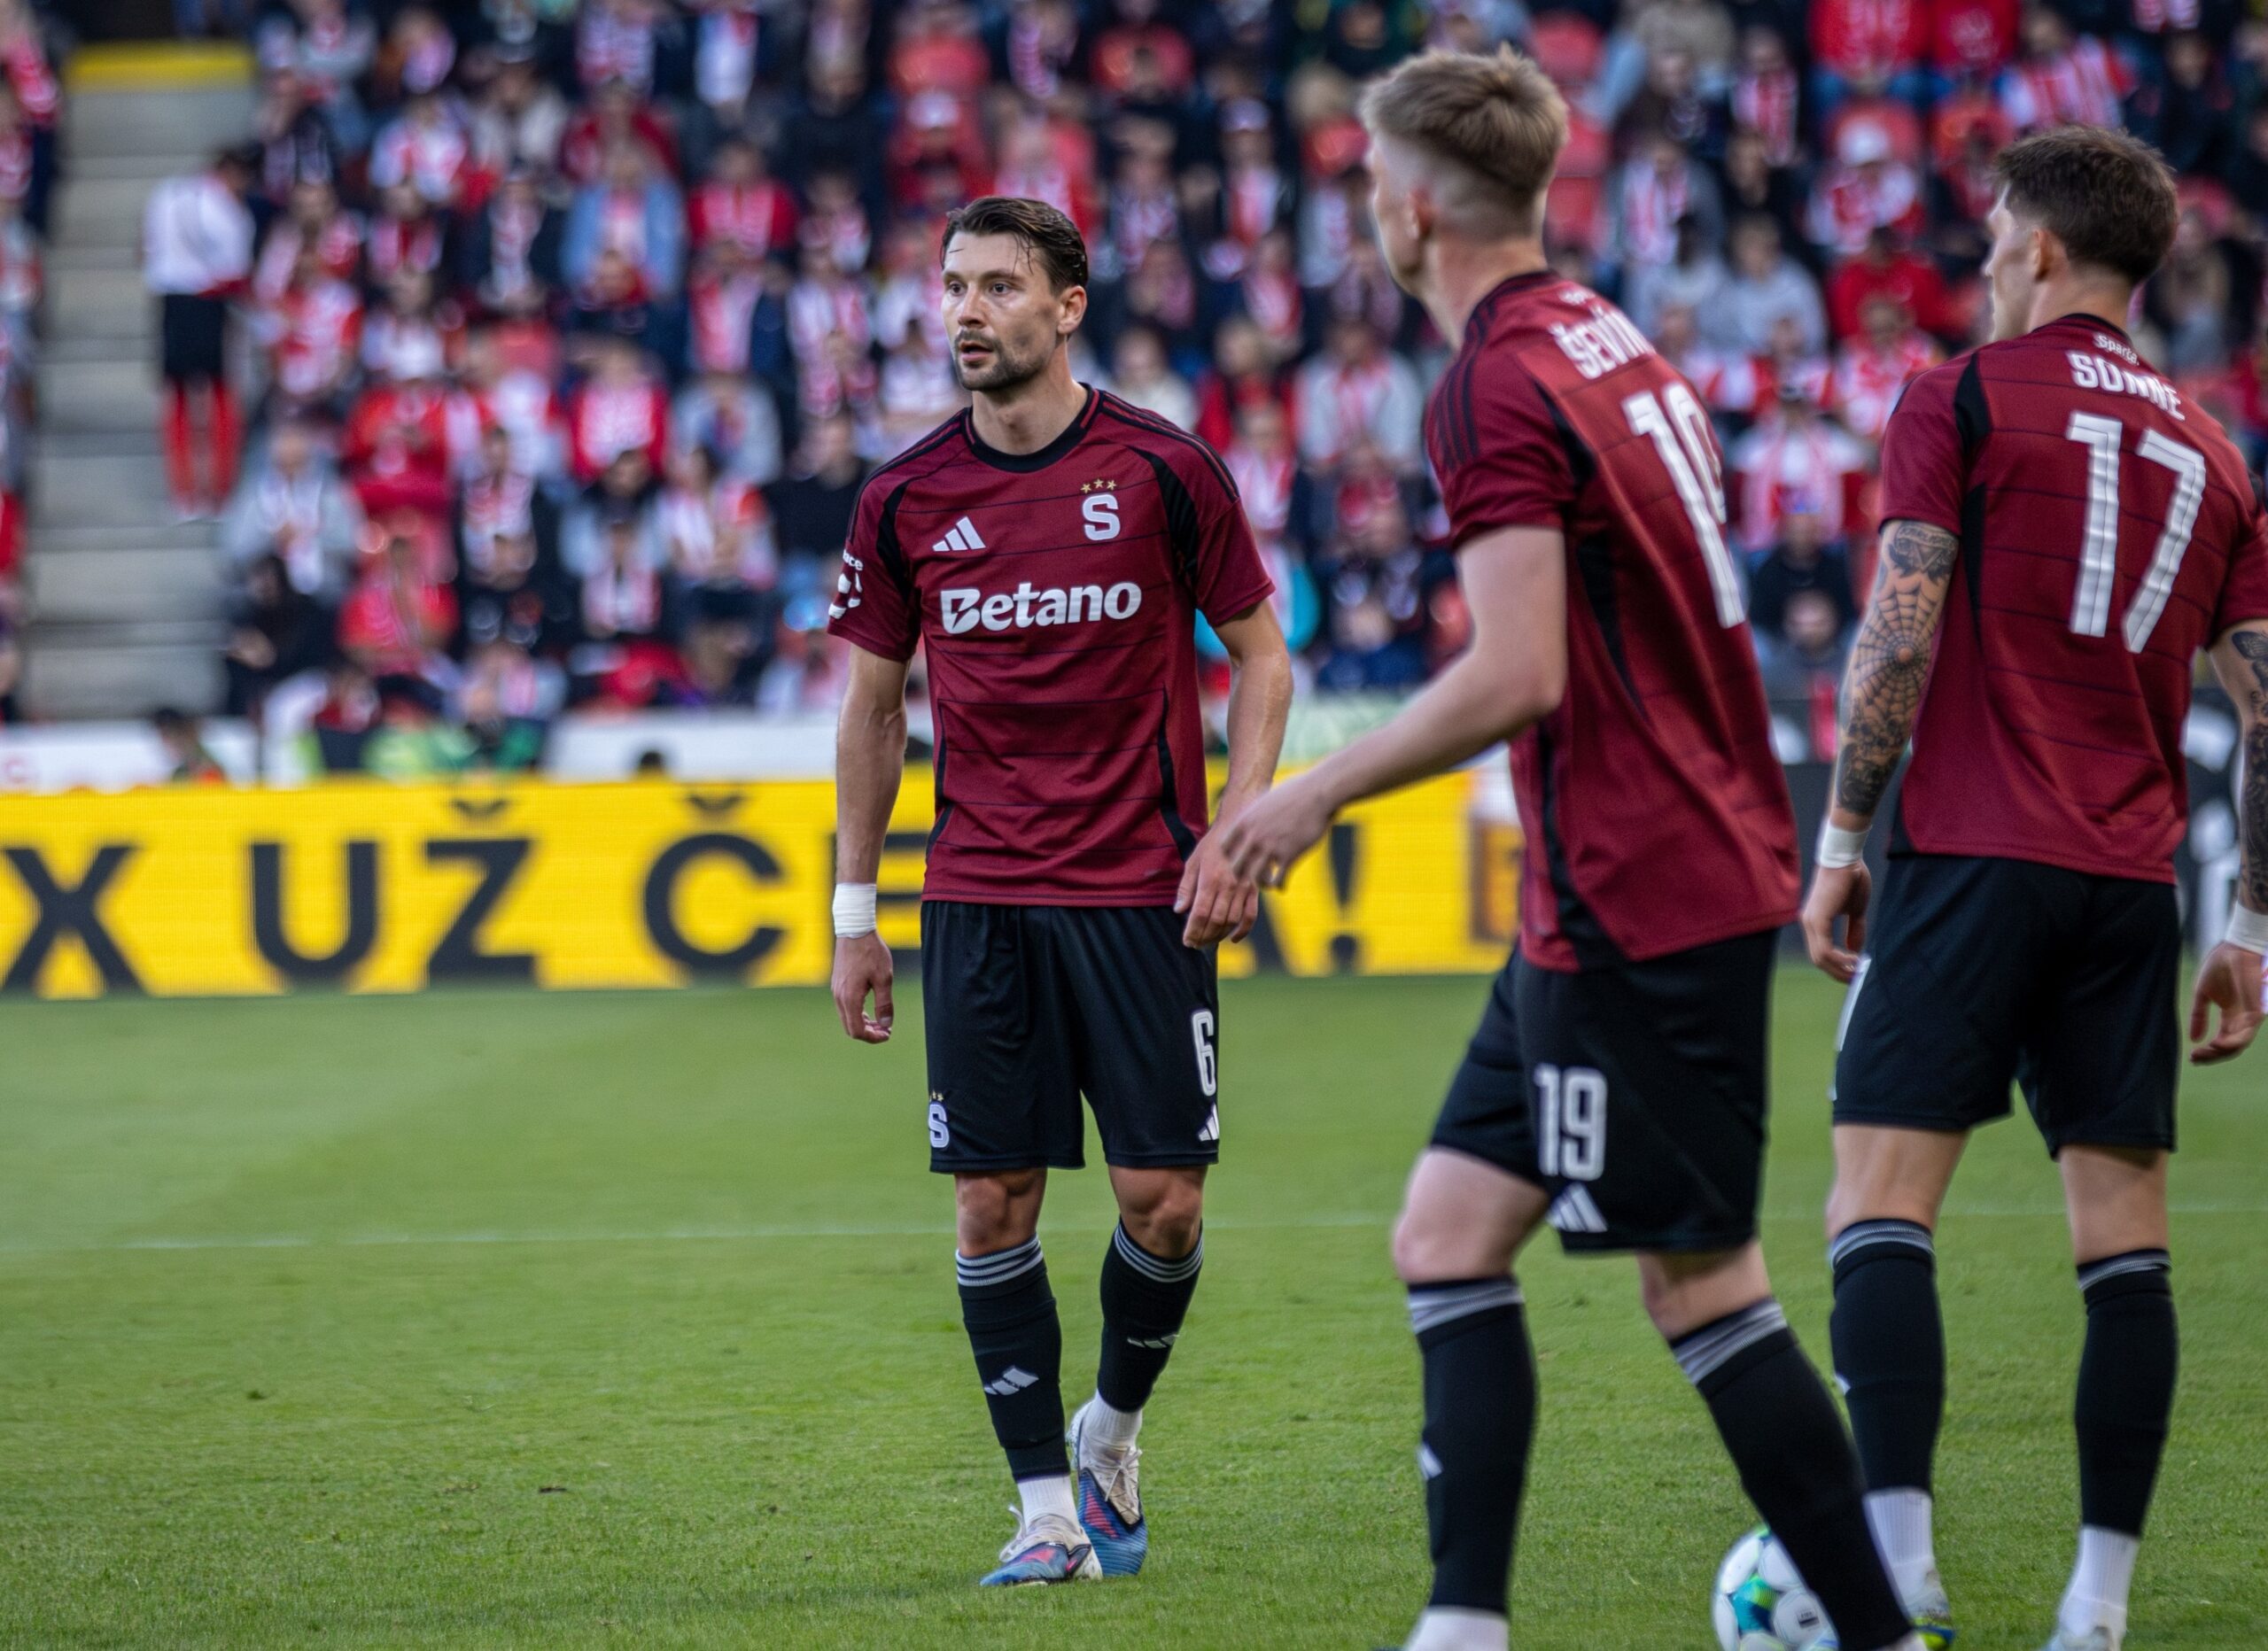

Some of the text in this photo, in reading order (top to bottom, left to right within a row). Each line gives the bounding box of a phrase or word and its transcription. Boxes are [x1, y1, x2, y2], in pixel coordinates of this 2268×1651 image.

[1083, 493, 1121, 541] S
[2067, 411, 2206, 654] 17
[941, 582, 1142, 634] Betano
[250, 797, 539, 990] UŽ
[1192, 1009, 1216, 1097] 6
[928, 1102, 950, 1148] S
[1534, 1063, 1607, 1181] 19
